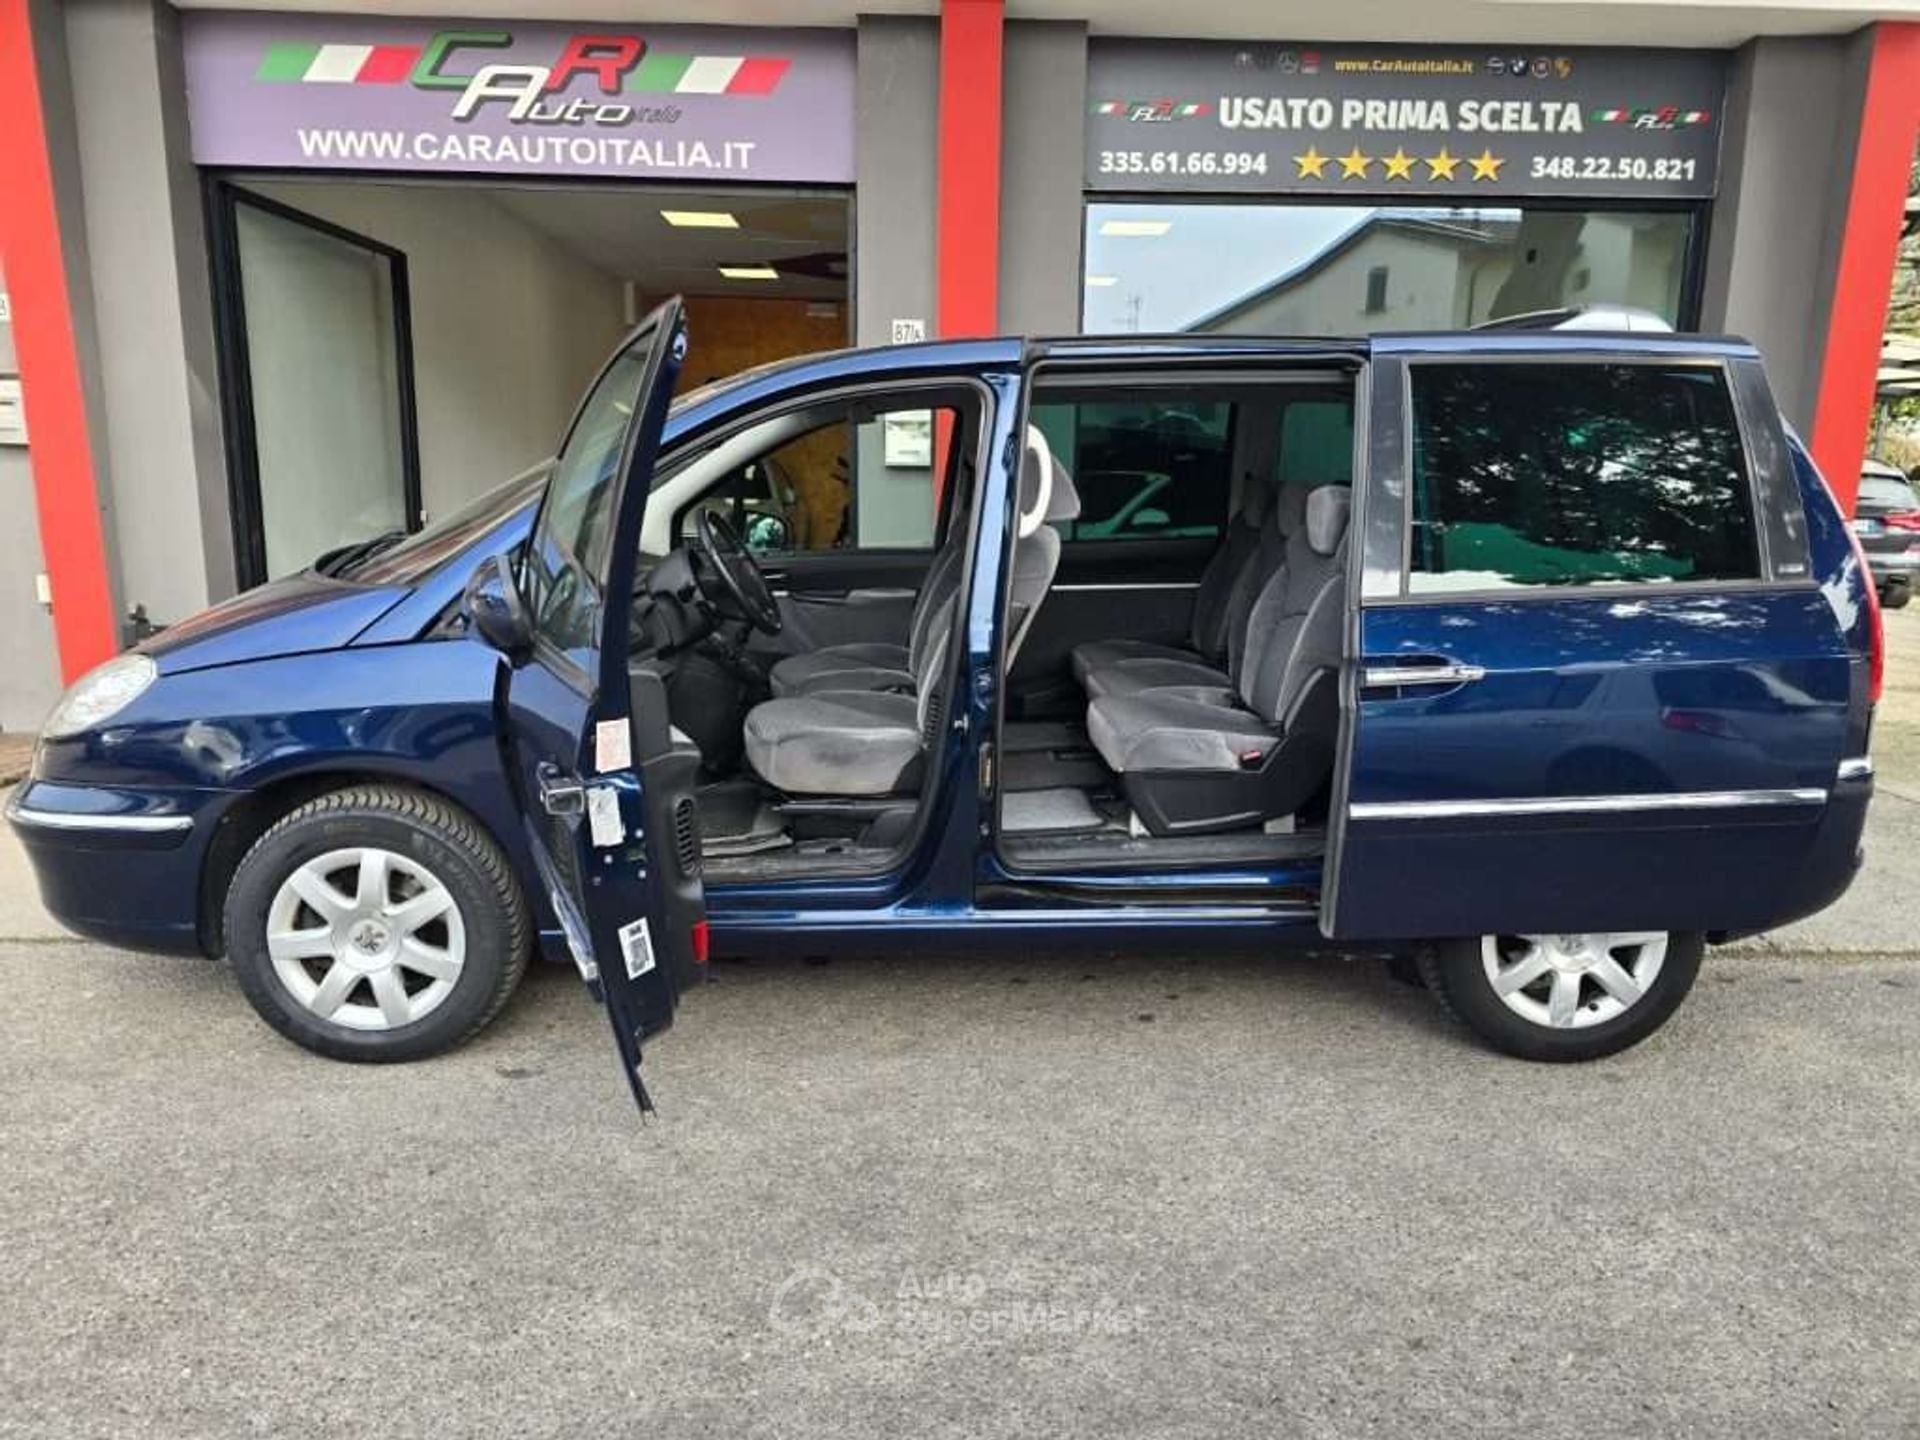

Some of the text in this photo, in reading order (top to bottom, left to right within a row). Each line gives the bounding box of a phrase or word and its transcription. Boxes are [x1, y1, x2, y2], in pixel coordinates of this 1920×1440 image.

[1219, 97, 1583, 133] USATO PRIMA SCELTA
[298, 129, 756, 171] WWW.CARAUTOITALIA.IT
[1099, 151, 1268, 175] 335.61.66.994
[1530, 157, 1696, 181] 348.22.50.821
